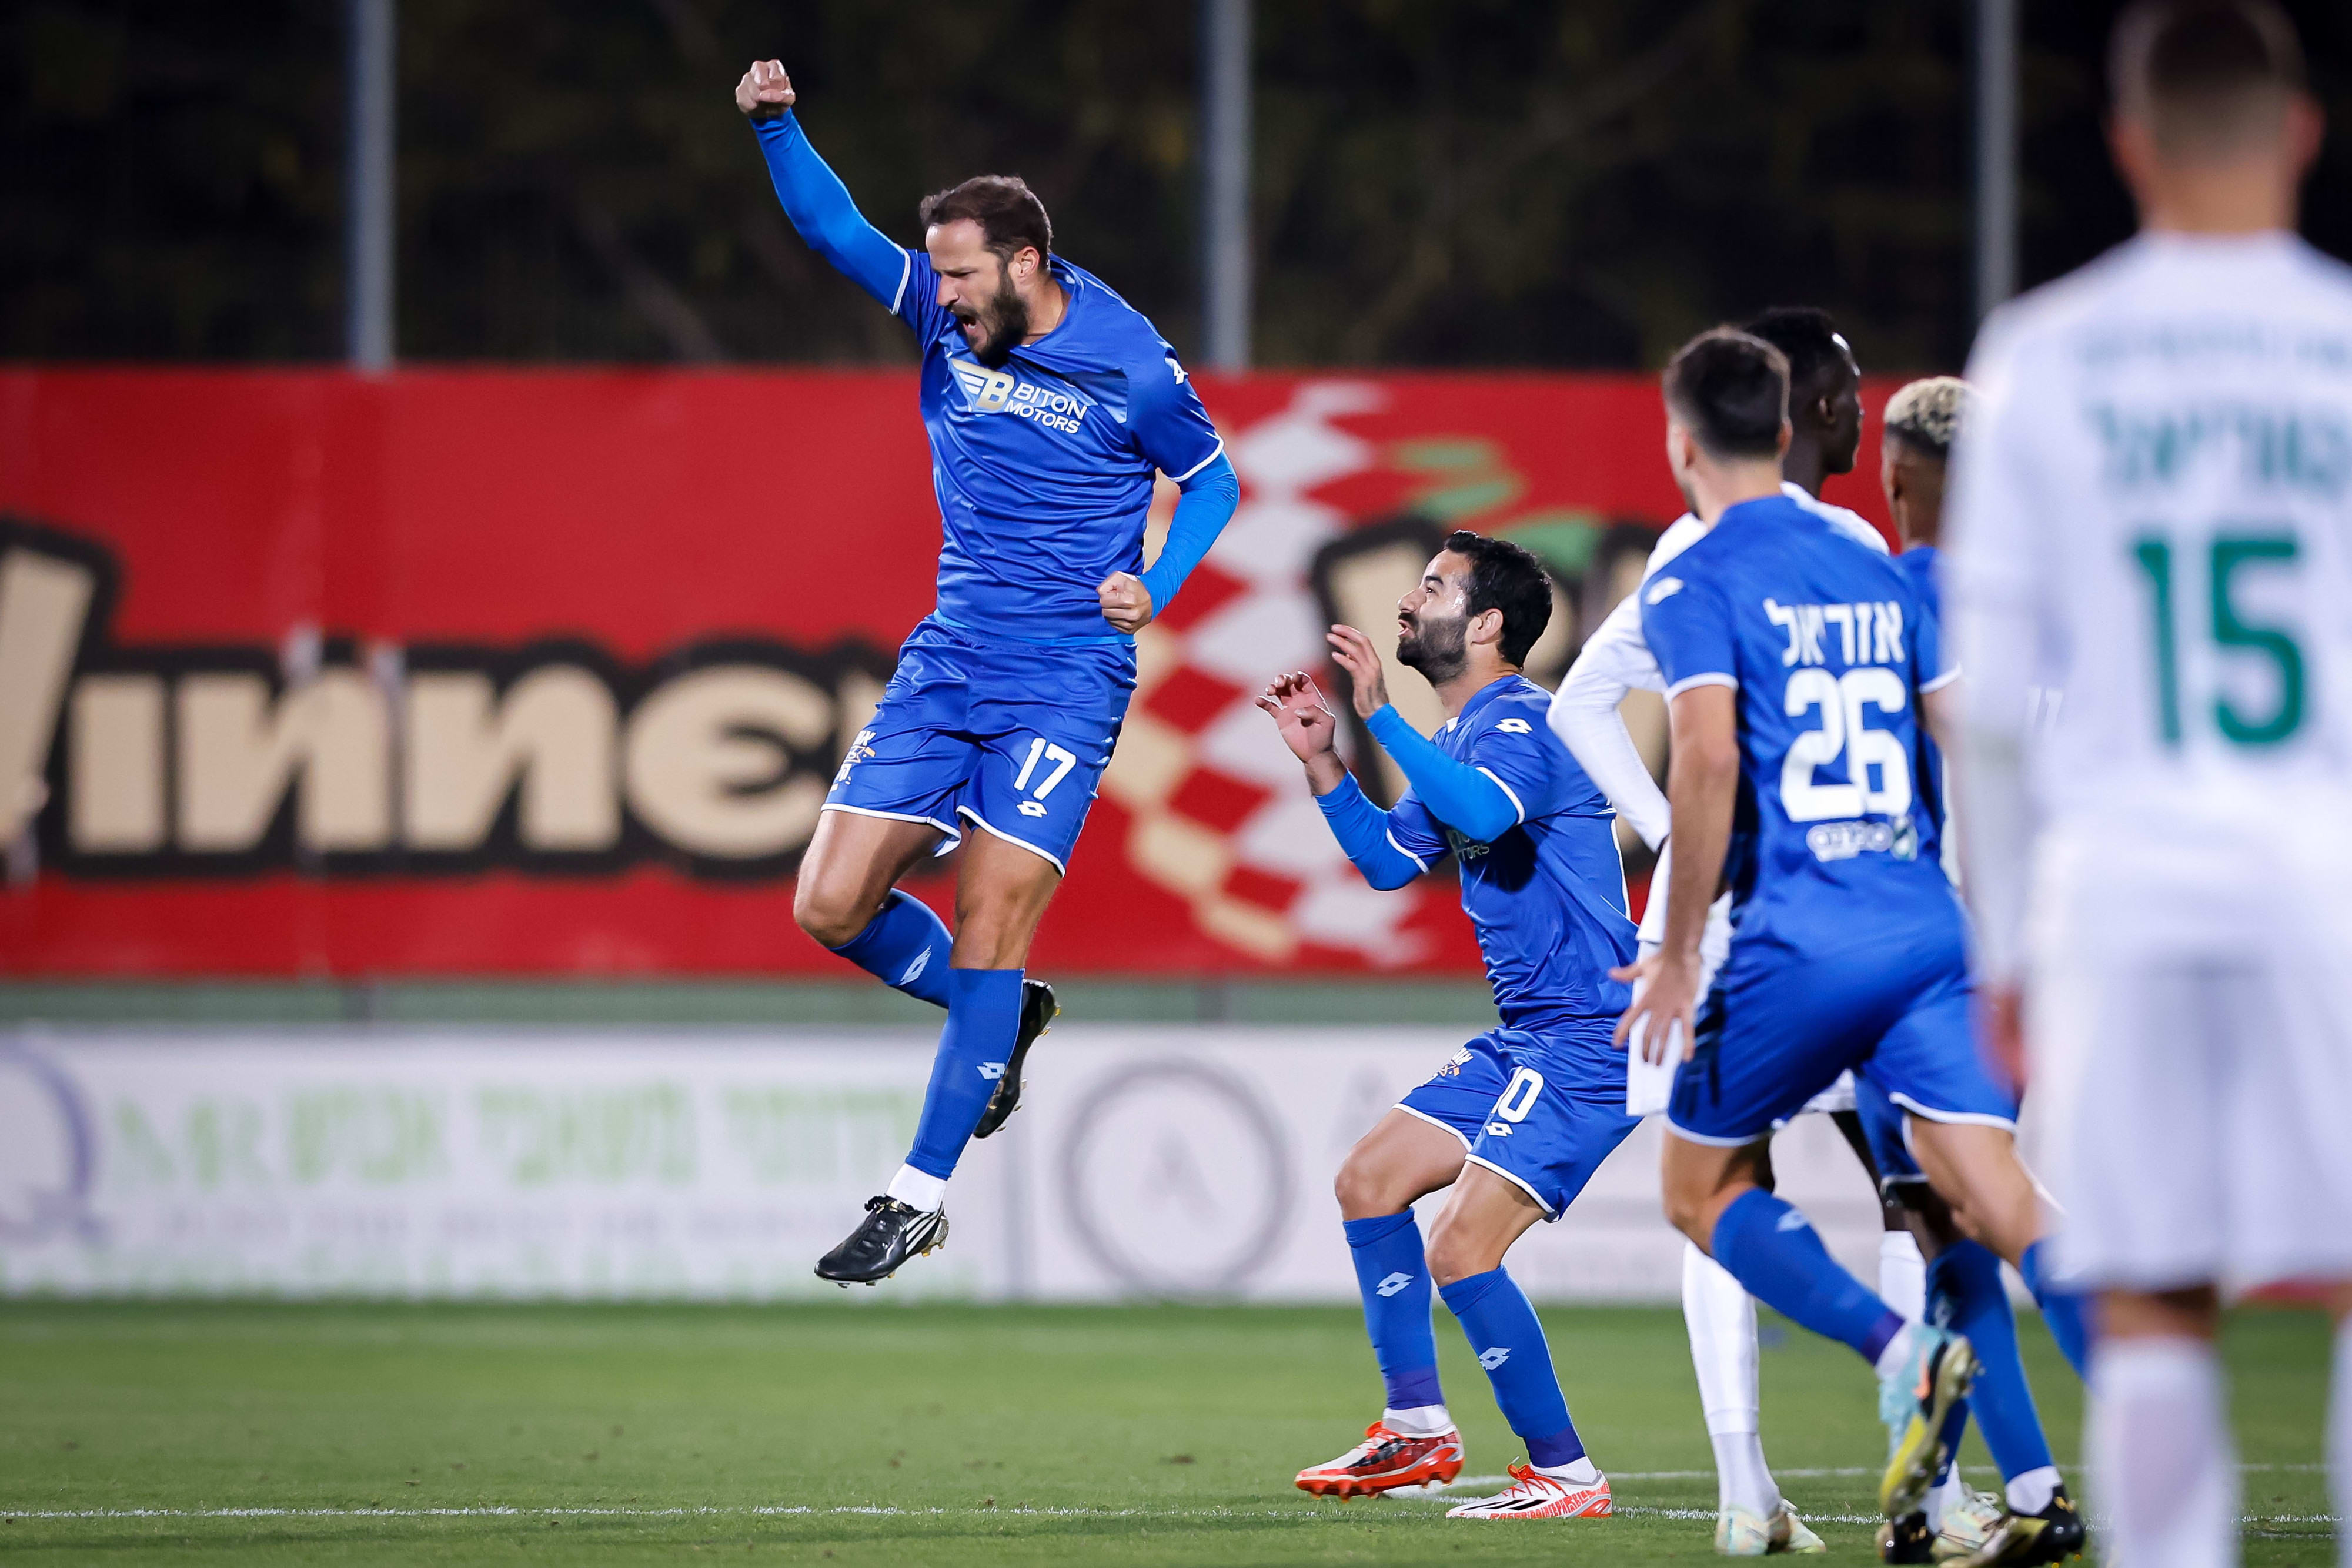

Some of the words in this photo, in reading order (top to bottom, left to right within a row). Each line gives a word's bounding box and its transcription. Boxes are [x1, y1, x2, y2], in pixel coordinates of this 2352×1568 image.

[1004, 399, 1081, 434] MOTORS
[1013, 382, 1088, 420] BITON
[2132, 534, 2306, 751] 15
[0, 547, 882, 858] inne
[1780, 667, 1912, 822] 26
[1014, 737, 1077, 801] 17
